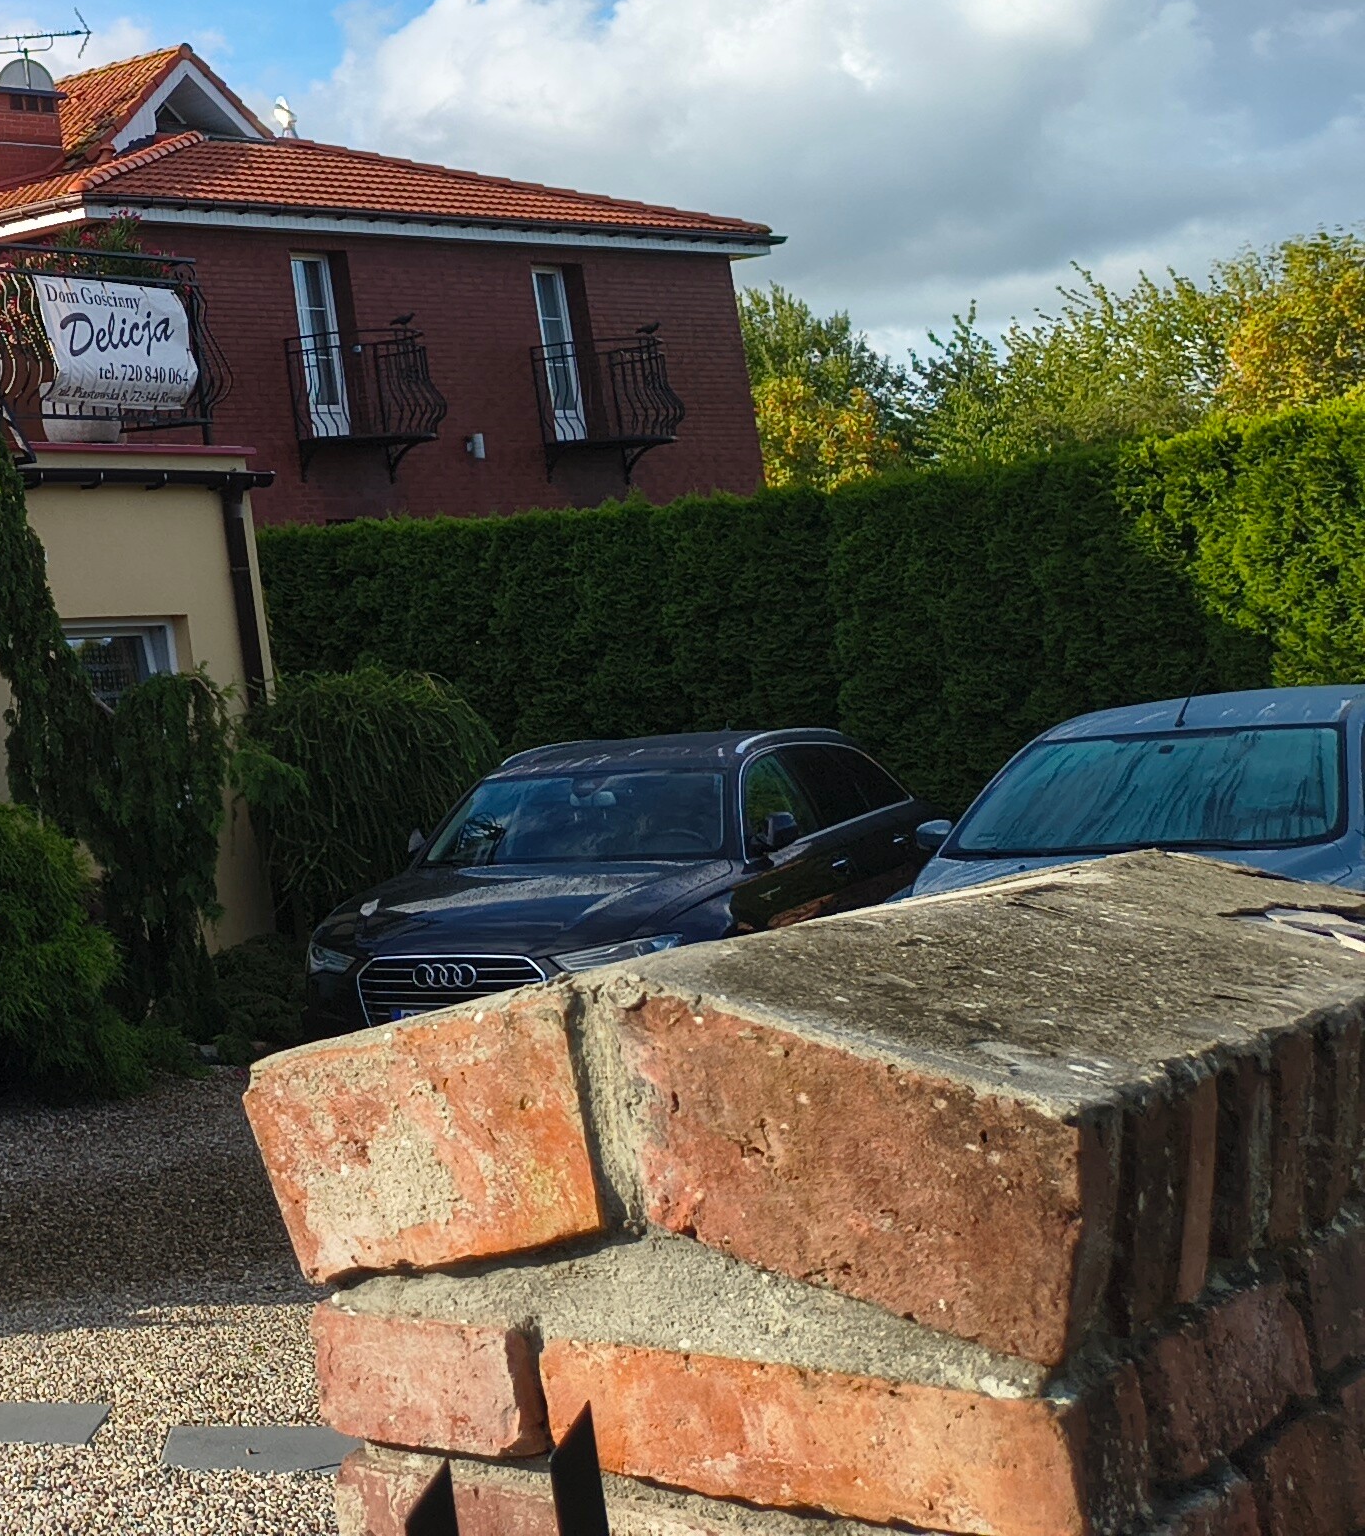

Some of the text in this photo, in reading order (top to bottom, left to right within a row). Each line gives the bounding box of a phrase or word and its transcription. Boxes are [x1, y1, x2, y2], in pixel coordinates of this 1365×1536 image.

[44, 283, 140, 314] Dom Gościnny
[59, 311, 175, 357] Delicja
[99, 362, 189, 385] tel. 720 840 064
[130, 390, 158, 403] 72-344
